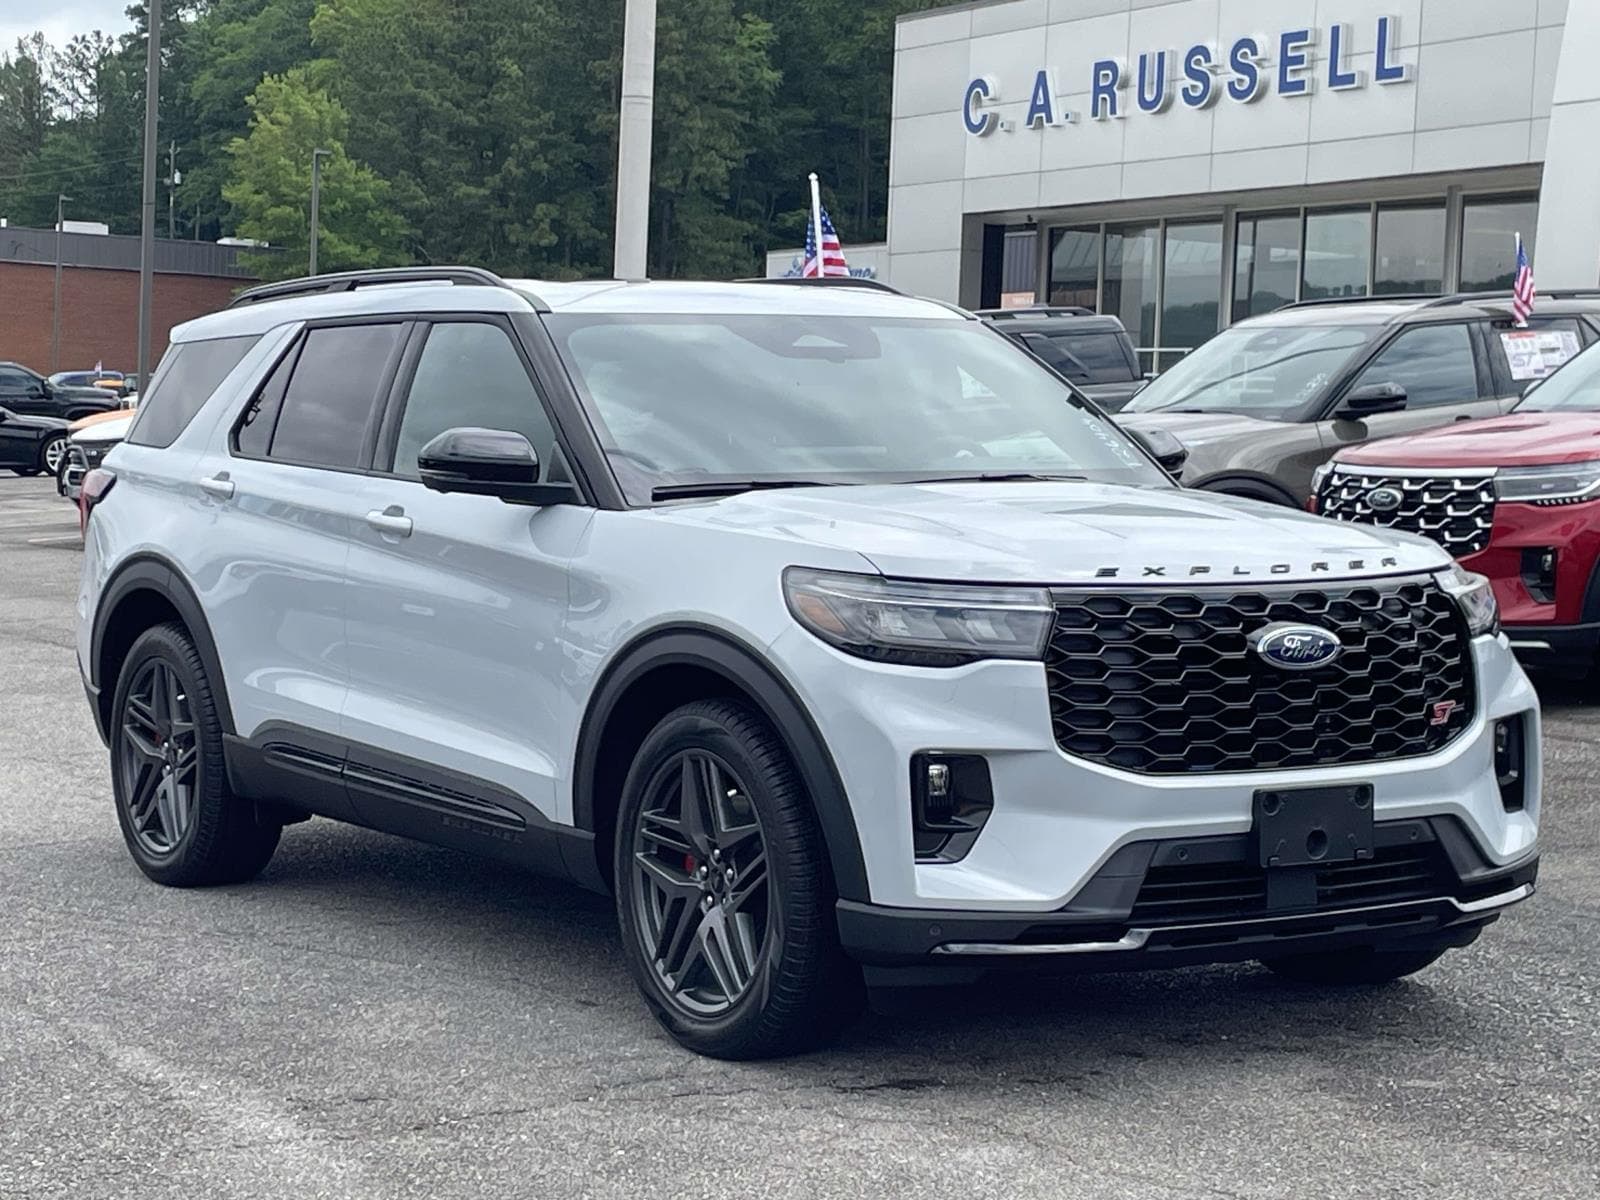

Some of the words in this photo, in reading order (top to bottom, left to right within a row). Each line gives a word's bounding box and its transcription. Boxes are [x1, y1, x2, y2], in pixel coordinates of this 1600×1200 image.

[962, 77, 1012, 136] C.
[1025, 69, 1079, 129] A.
[1091, 16, 1407, 119] RUSSELL
[1093, 556, 1398, 579] EXPLORER
[1430, 699, 1457, 726] ST
